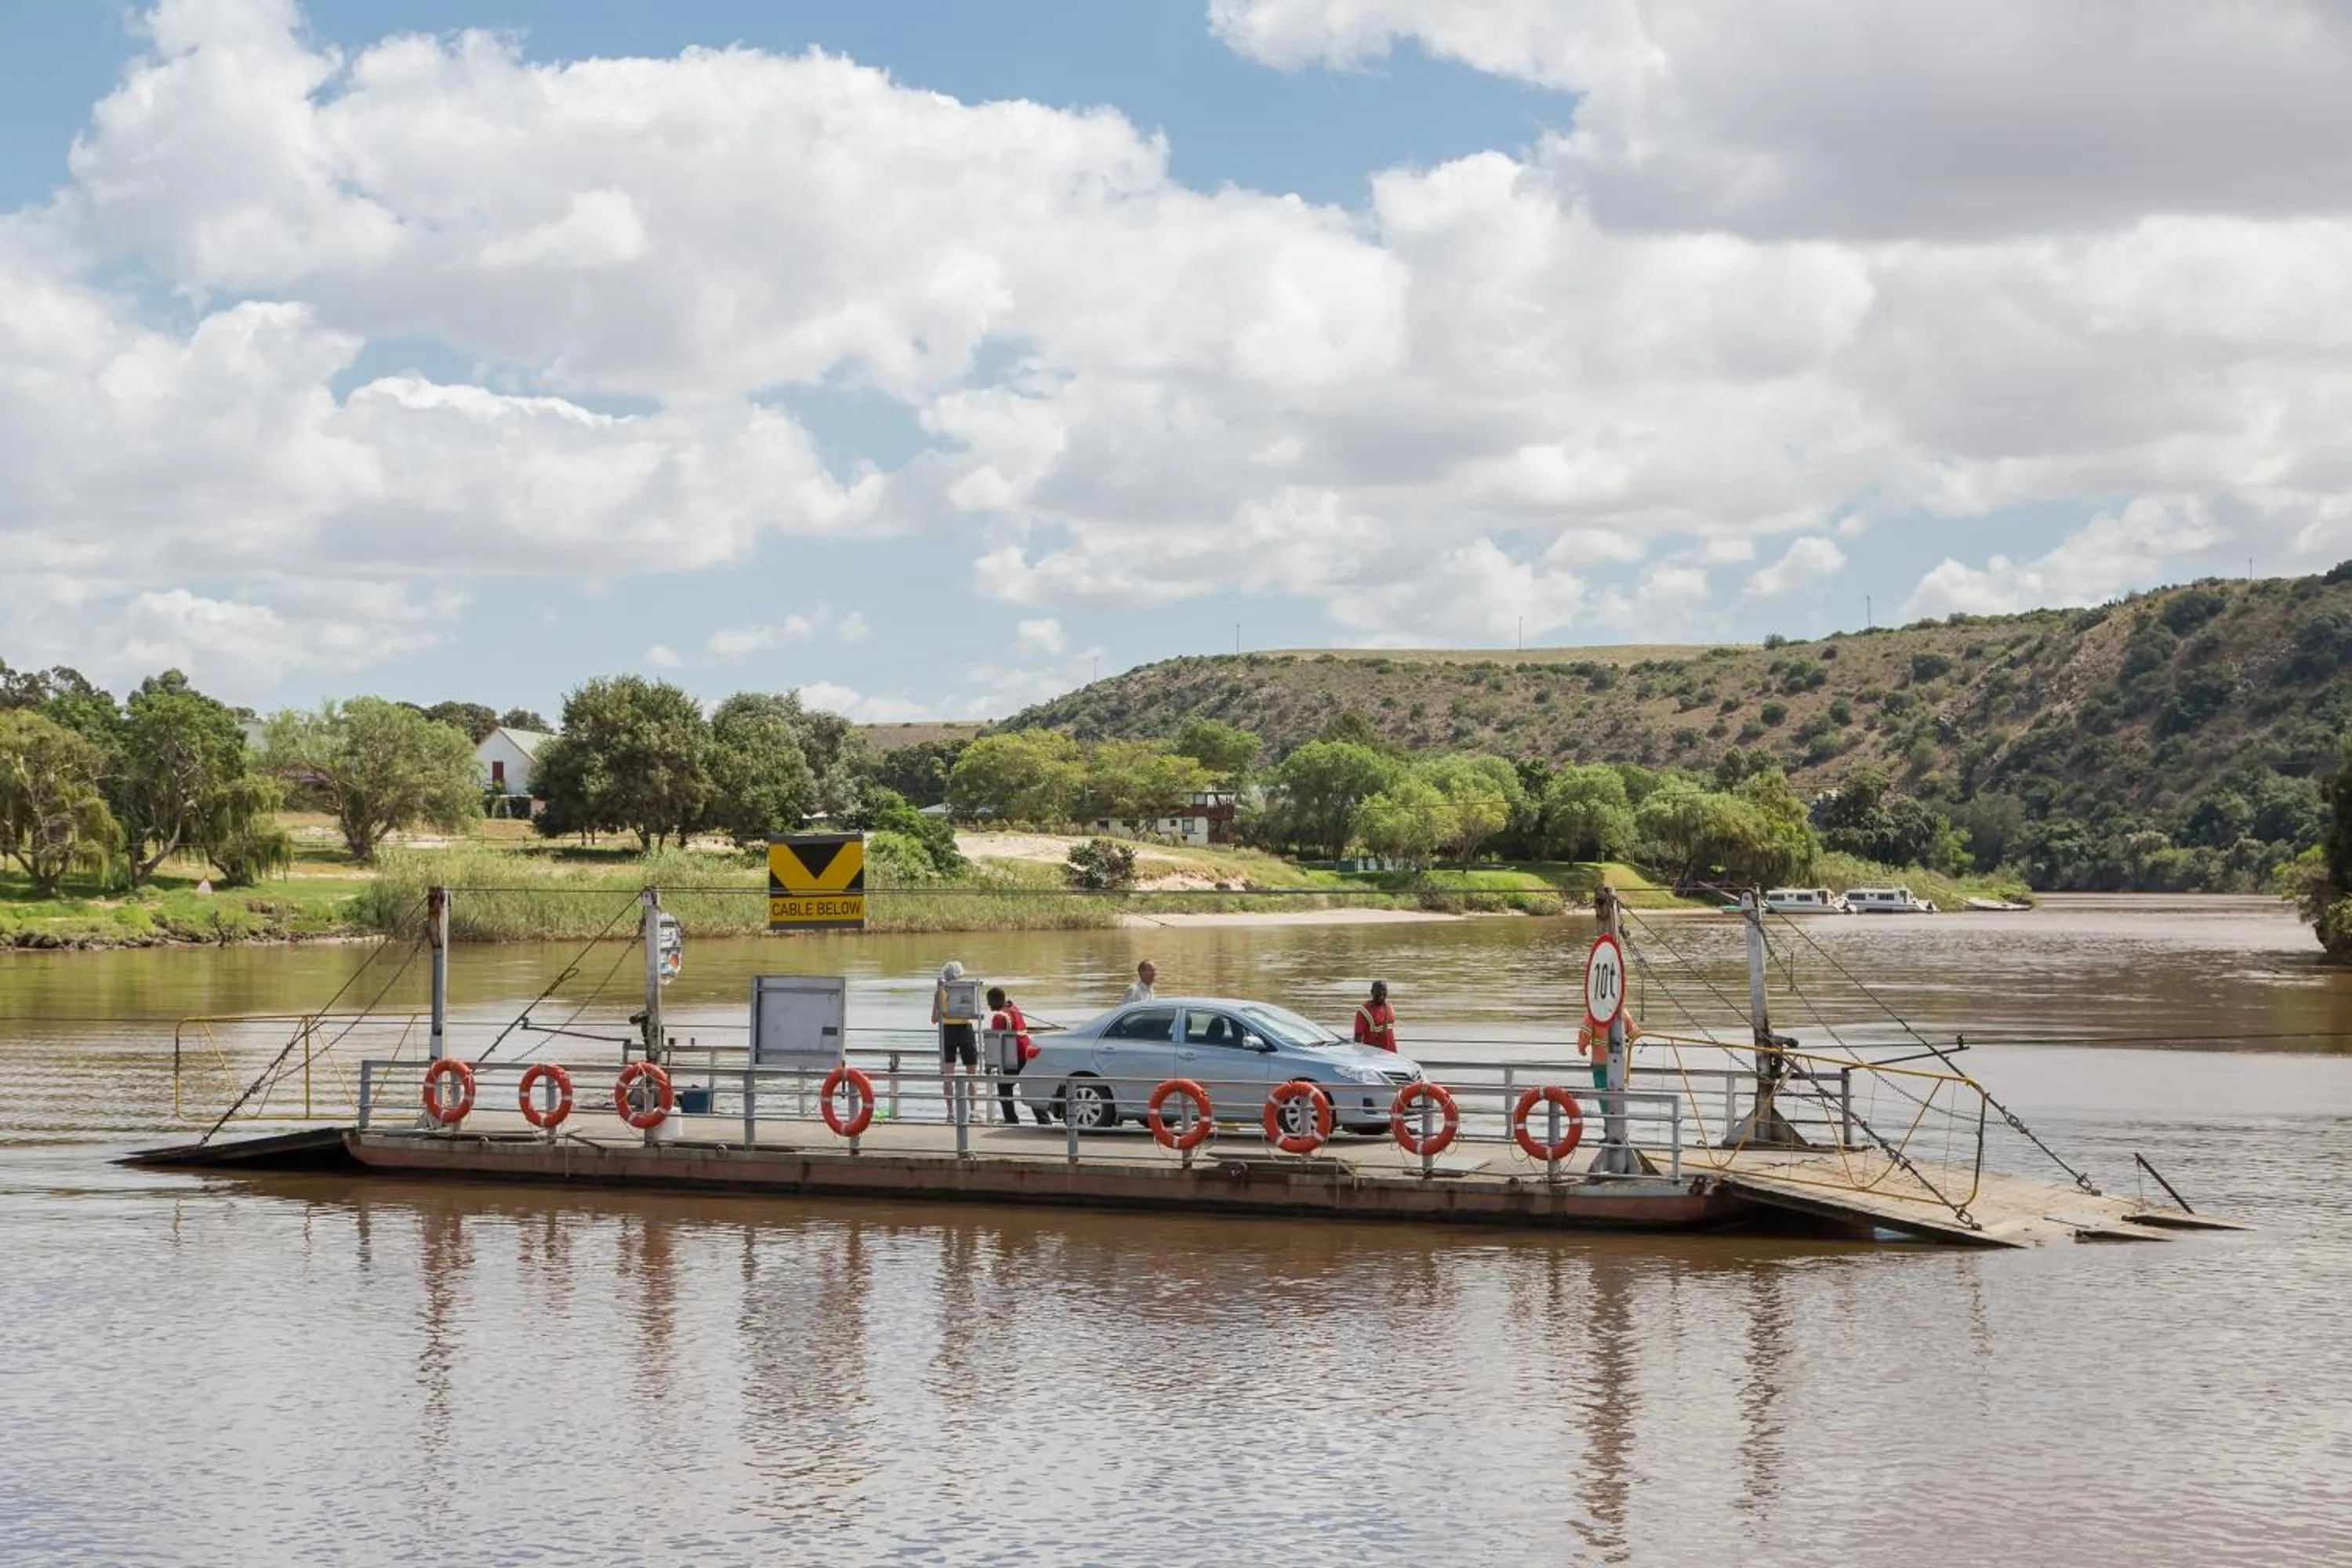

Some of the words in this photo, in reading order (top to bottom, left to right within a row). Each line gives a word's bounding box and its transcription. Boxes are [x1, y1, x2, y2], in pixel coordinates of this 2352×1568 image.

[771, 902, 813, 916] CABLE
[816, 900, 861, 916] BELOW
[1594, 962, 1616, 1000] 10t
